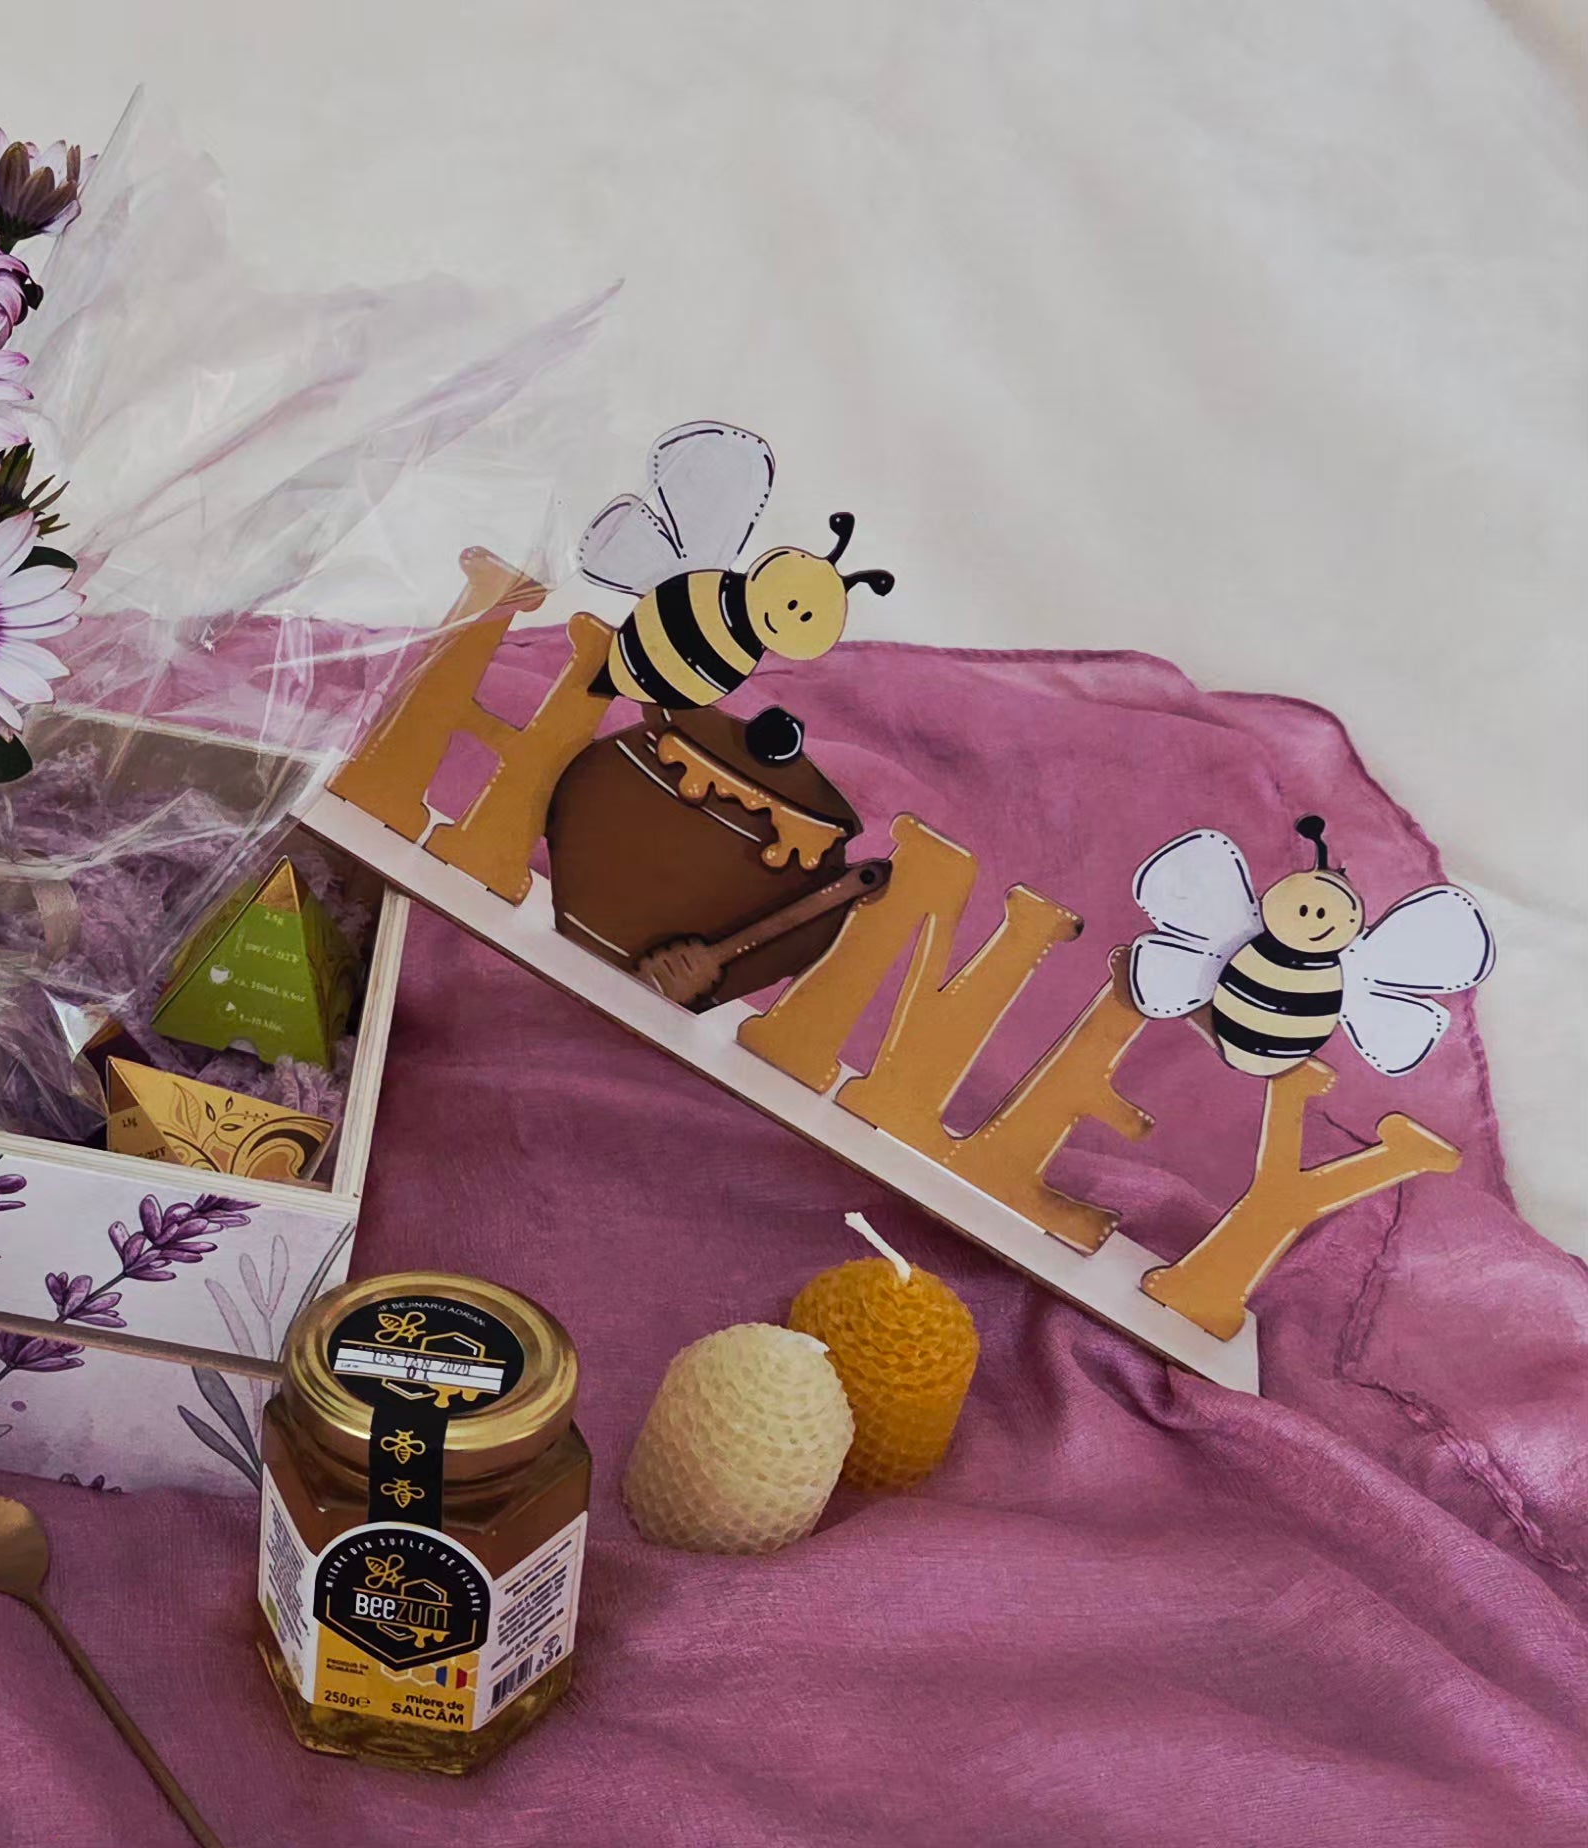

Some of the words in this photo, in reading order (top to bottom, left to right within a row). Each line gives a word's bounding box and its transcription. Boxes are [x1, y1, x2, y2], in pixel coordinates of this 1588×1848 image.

[349, 1541, 373, 1556] DIN
[379, 1537, 435, 1555] SUFLET
[439, 1553, 455, 1567] DE
[391, 1702, 465, 1726] SALCÂM
[405, 1694, 445, 1708] miere
[446, 1700, 465, 1711] de
